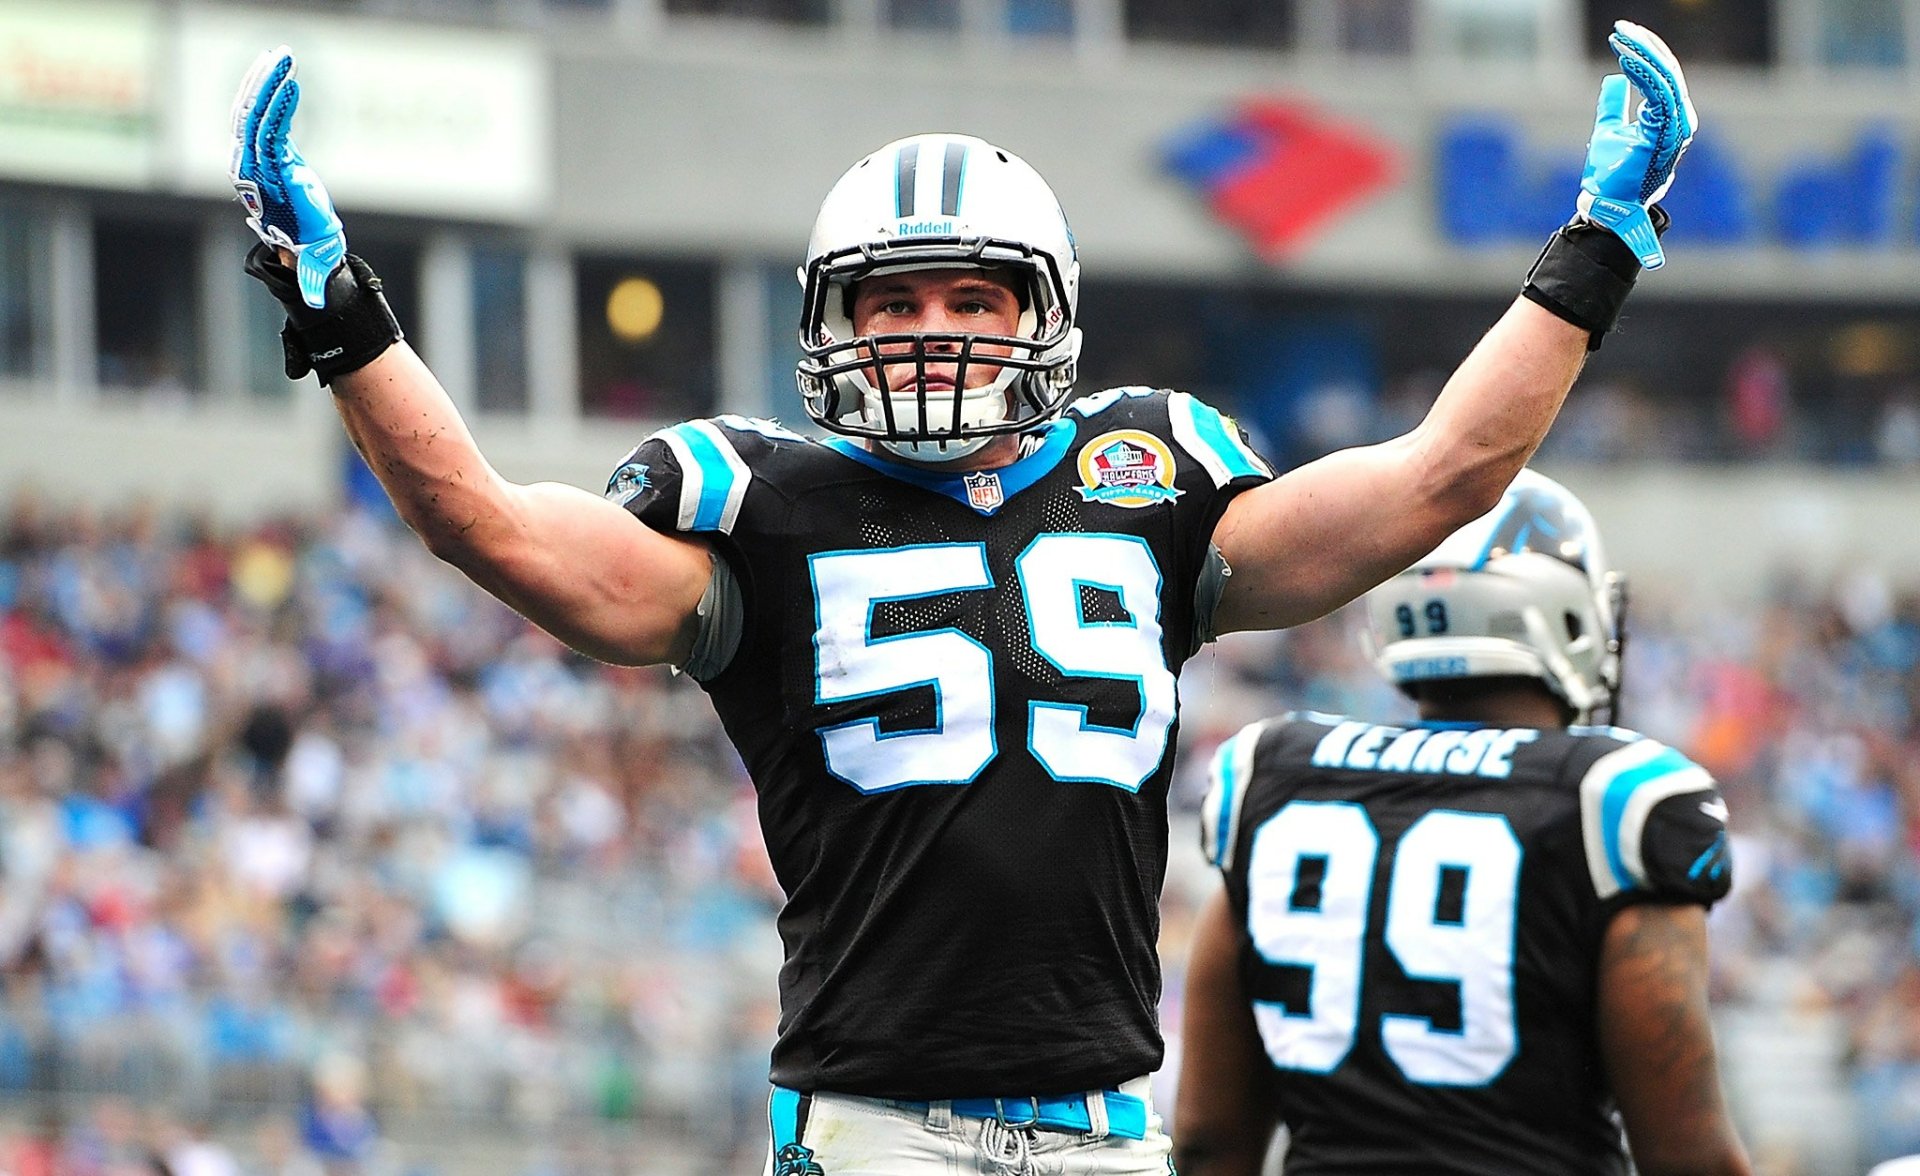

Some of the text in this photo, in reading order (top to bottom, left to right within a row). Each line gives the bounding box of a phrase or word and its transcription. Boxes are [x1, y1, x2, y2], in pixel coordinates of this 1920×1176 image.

[899, 222, 952, 235] Riddell
[1101, 470, 1125, 481] HALL
[1131, 469, 1155, 480] FAME
[973, 487, 999, 504] NFL
[1396, 599, 1448, 637] 99
[807, 532, 1176, 795] 59
[1312, 721, 1540, 778] KEARSE
[1247, 799, 1525, 1089] 99
